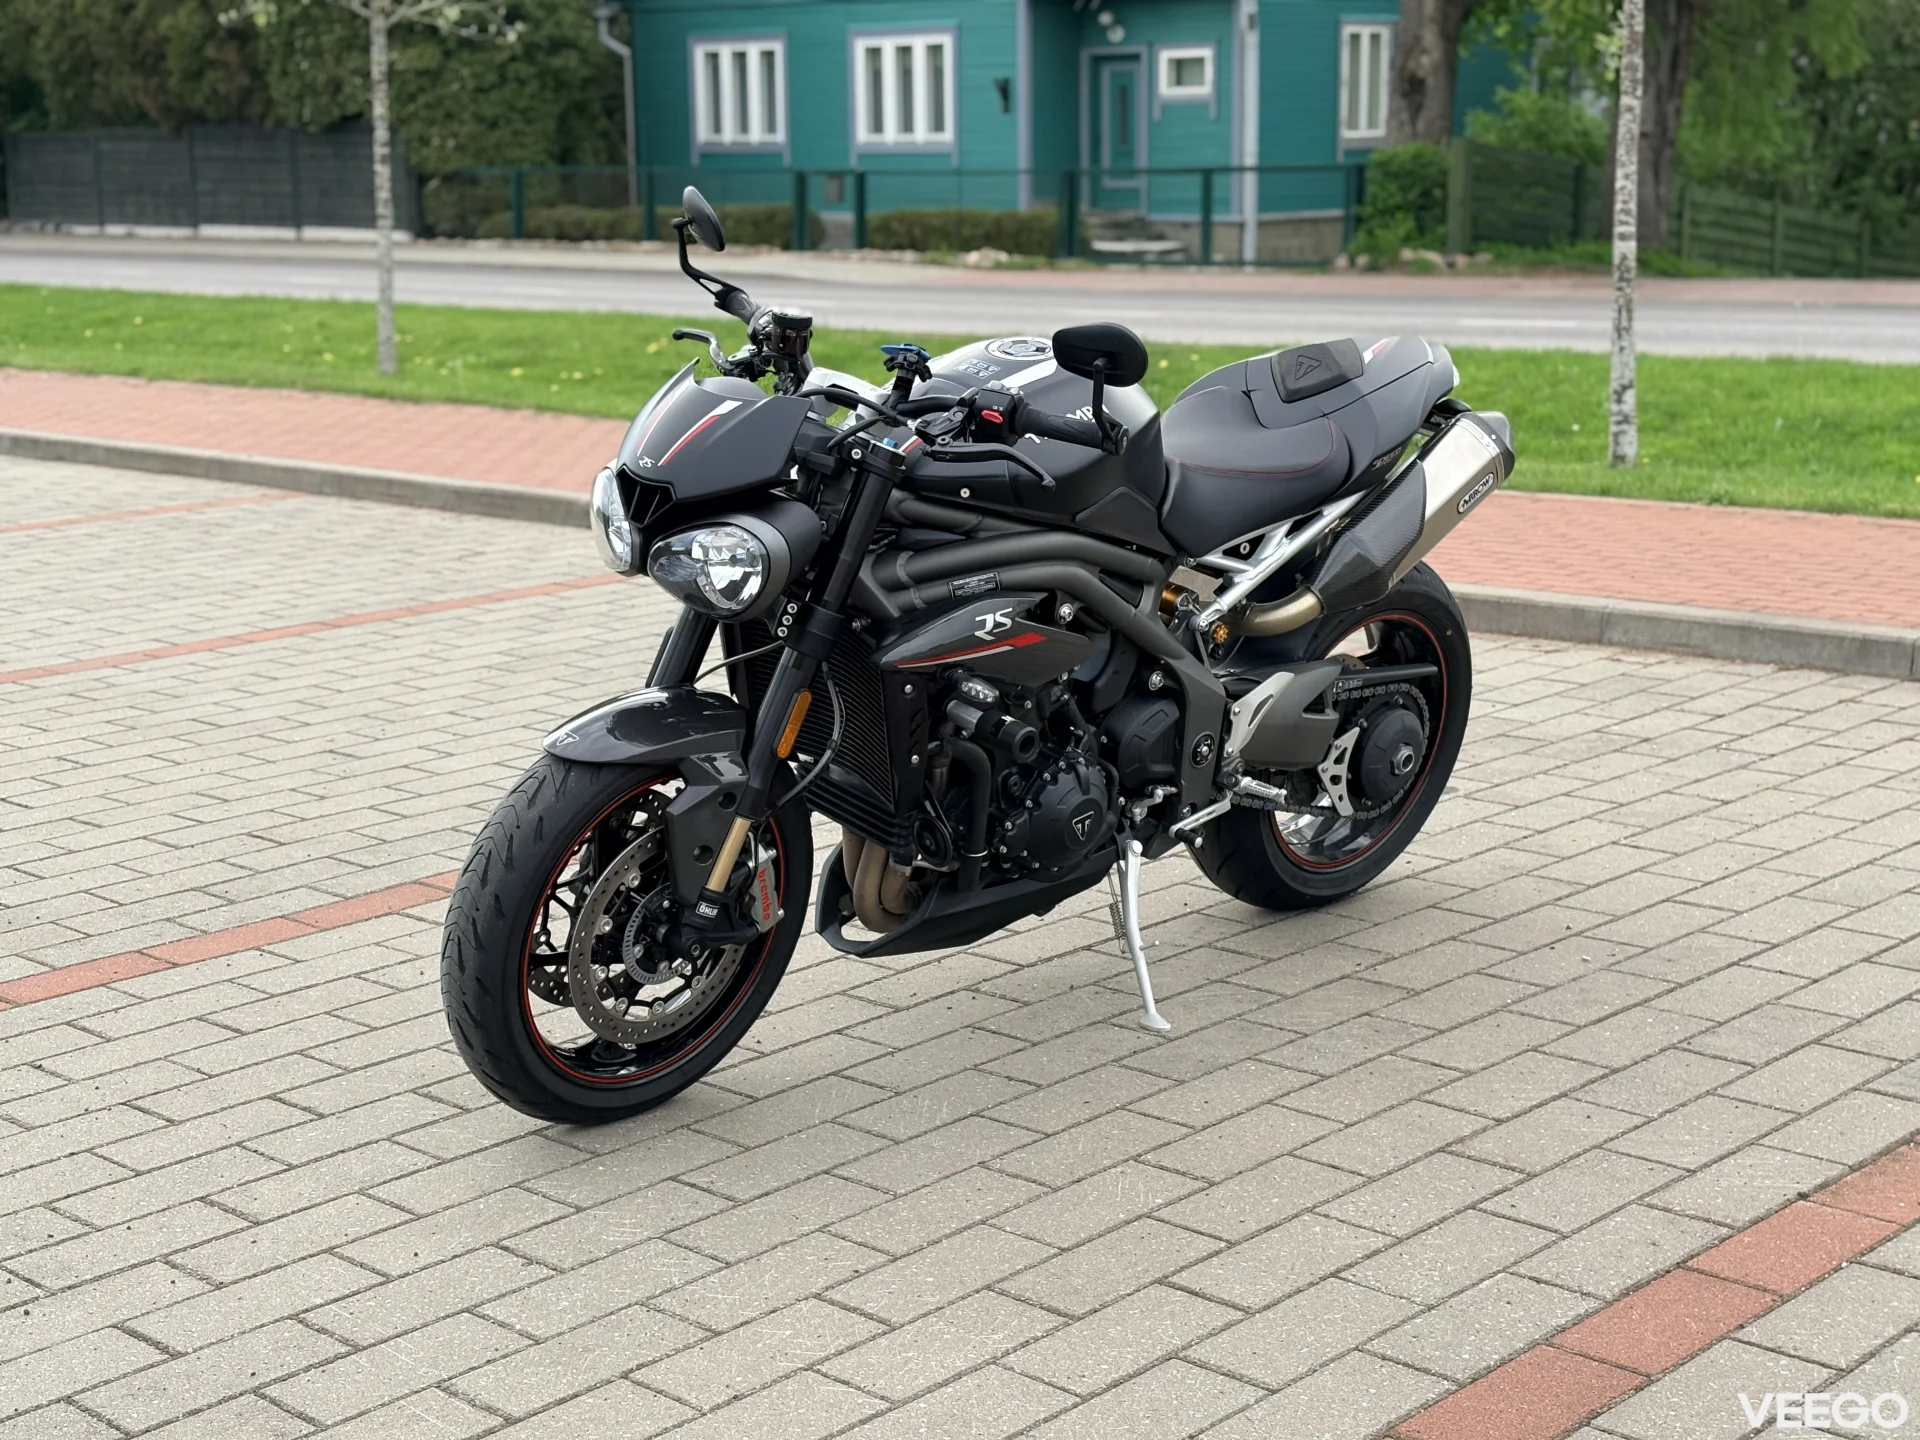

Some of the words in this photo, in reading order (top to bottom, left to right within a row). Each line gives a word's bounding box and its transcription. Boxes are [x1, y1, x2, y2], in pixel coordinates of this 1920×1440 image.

[1461, 475, 1491, 509] ARROW
[974, 607, 1013, 640] RS
[757, 867, 773, 921] brembo
